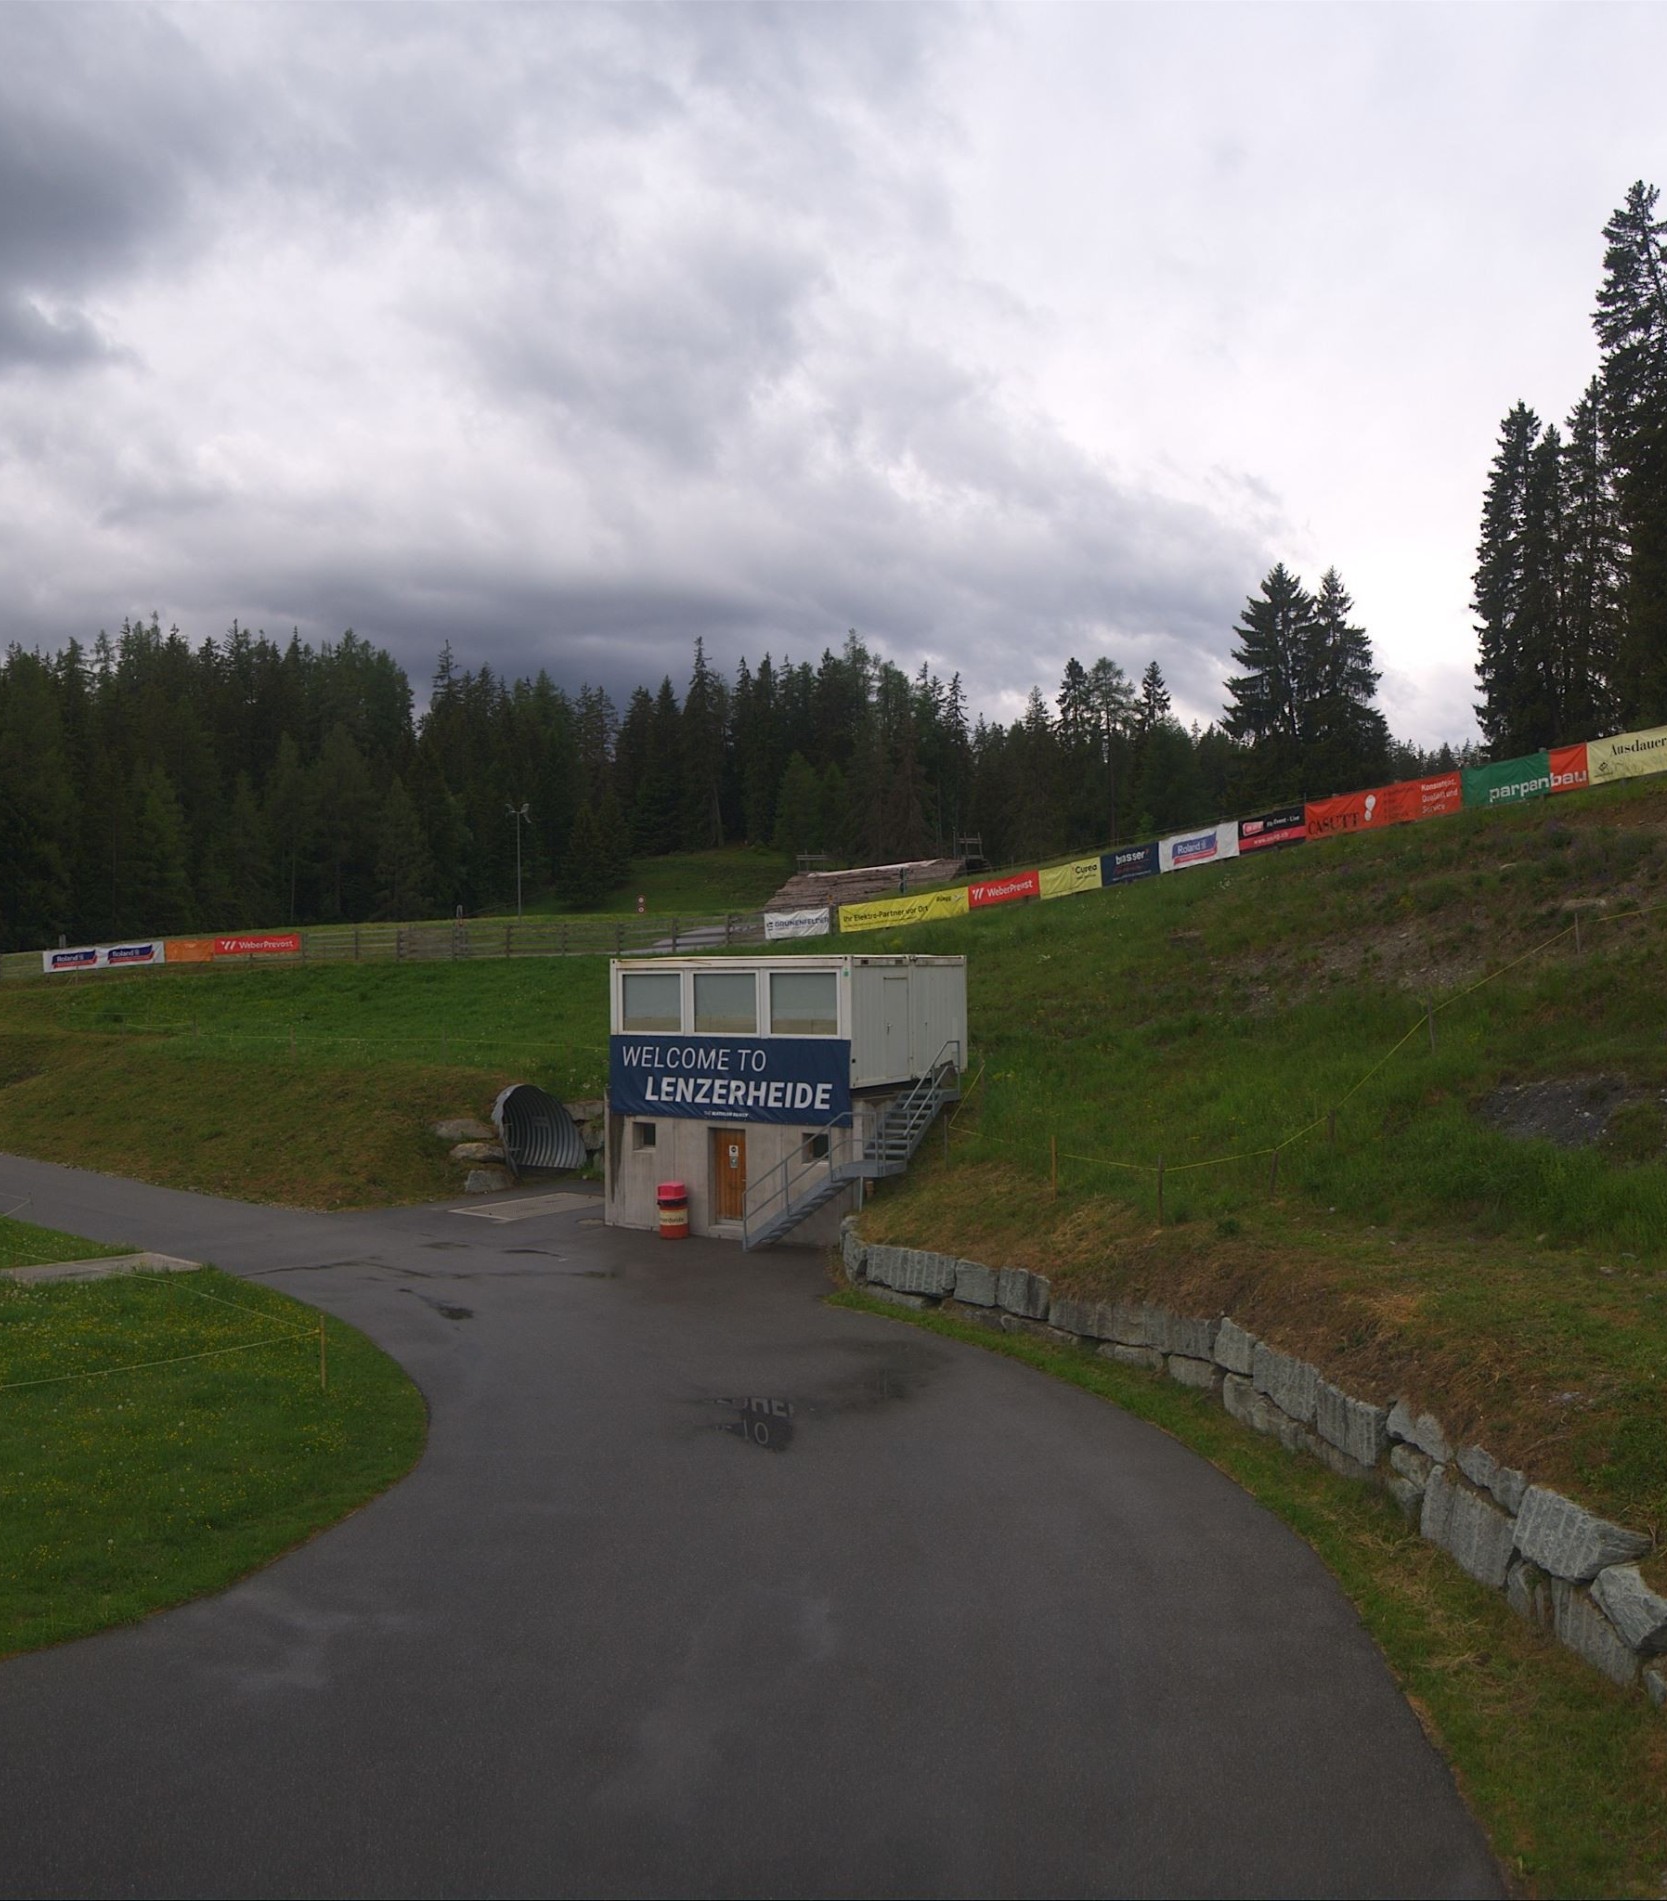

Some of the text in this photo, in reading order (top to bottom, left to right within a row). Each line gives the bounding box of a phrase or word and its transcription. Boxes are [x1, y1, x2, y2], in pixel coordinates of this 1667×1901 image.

[1488, 769, 1588, 803] parpanbau
[239, 939, 294, 950] WeberPrevost
[621, 1046, 768, 1072] WELCOME TO
[644, 1076, 834, 1110] LENZERHEIDE
